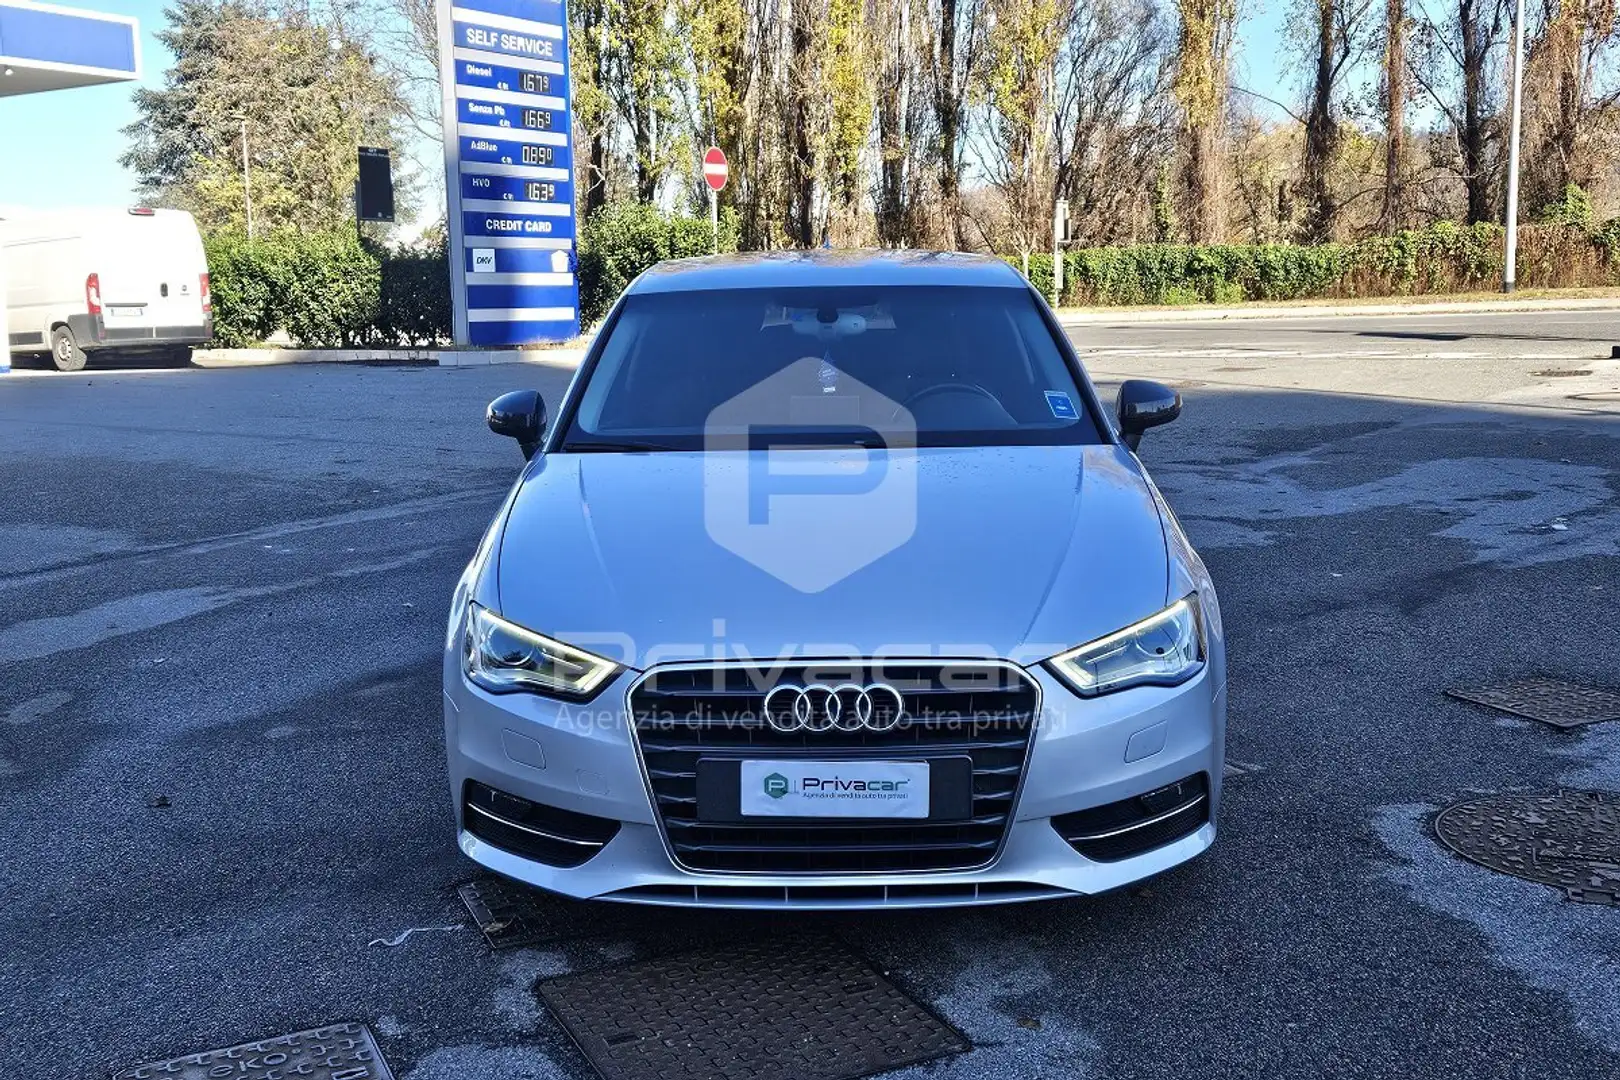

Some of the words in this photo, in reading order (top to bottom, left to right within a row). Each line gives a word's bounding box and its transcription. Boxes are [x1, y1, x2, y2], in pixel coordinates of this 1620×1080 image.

[466, 28, 498, 47] SELF
[500, 34, 553, 56] SERVICE
[466, 64, 492, 77] Diesel
[494, 105, 505, 116] Pb
[472, 178, 490, 188] HVO
[486, 219, 523, 231] CREDIT
[524, 221, 552, 232] CARD
[803, 775, 909, 791] Privacar
